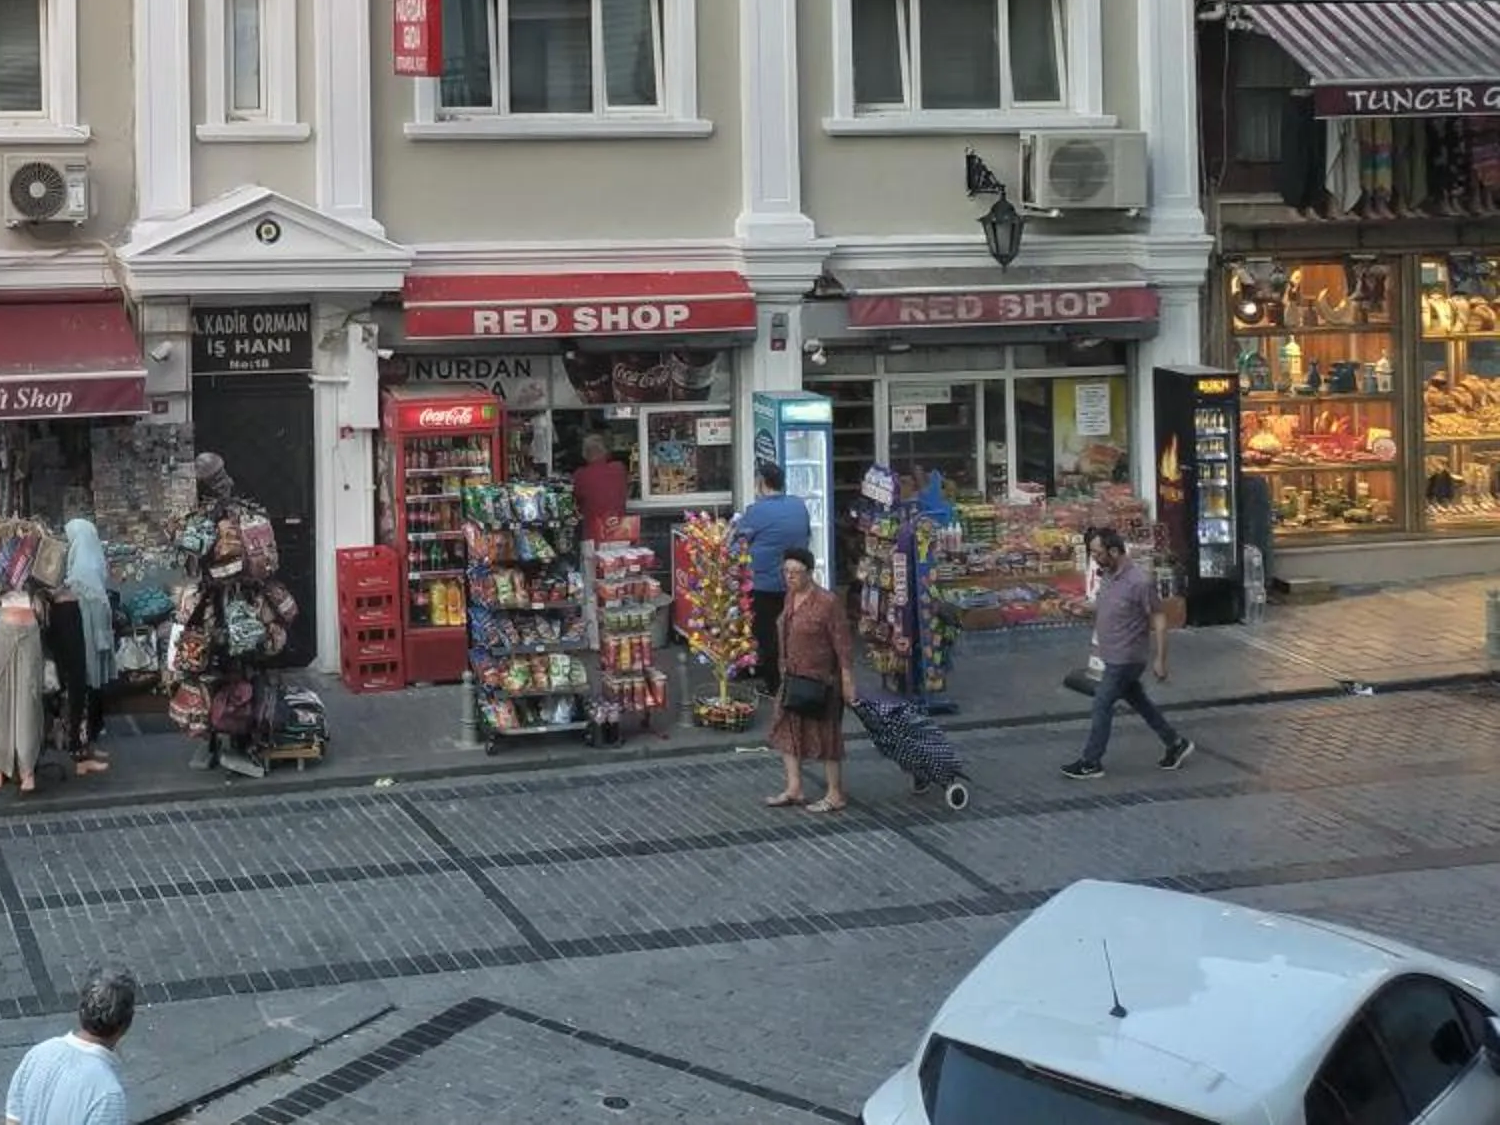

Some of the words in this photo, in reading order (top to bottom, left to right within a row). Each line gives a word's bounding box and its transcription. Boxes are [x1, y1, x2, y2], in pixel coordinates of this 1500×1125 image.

[1346, 86, 1476, 112] TUNCER
[473, 308, 558, 334] RED
[573, 304, 690, 331] SHOP
[899, 295, 983, 322] RED
[998, 290, 1111, 318] SHOP
[253, 312, 308, 334] ORMAN
[235, 338, 291, 354] HANI
[415, 358, 531, 380] NURDAN
[13, 387, 74, 413] Shop
